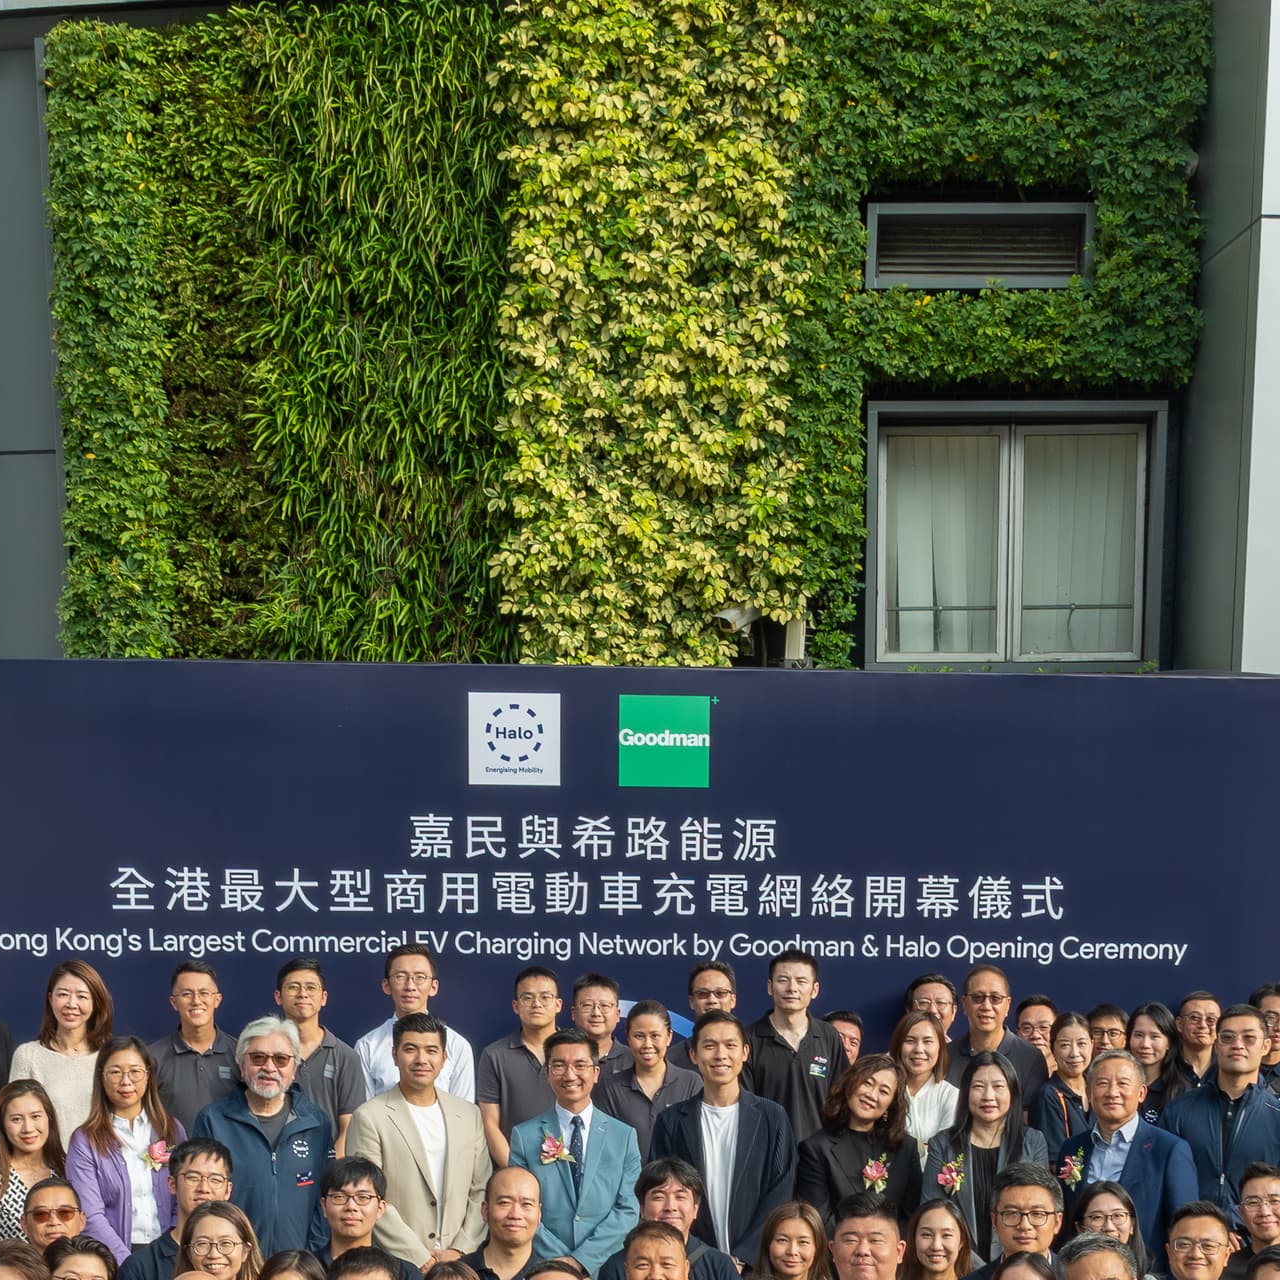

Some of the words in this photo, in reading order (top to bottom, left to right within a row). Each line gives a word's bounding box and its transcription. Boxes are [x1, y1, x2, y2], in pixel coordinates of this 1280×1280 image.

[495, 726, 534, 740] Halo
[619, 728, 710, 747] Goodman
[485, 766, 518, 774] Energising
[519, 767, 544, 775] Mobility
[409, 813, 778, 862] 嘉民與希路能源
[110, 867, 1065, 920] 全港最大型商用電動車充電網絡開幕儀式
[55, 927, 142, 958] Kong's
[148, 927, 246, 958] Largest
[251, 928, 407, 954] Commercial
[454, 930, 572, 961] Charging
[579, 931, 687, 956] Network
[693, 932, 724, 962] by
[729, 932, 855, 957] Goodman
[861, 934, 879, 958] &
[886, 934, 941, 958] Halo
[946, 934, 1054, 965] Opening
[1059, 935, 1189, 966] Ceremony
